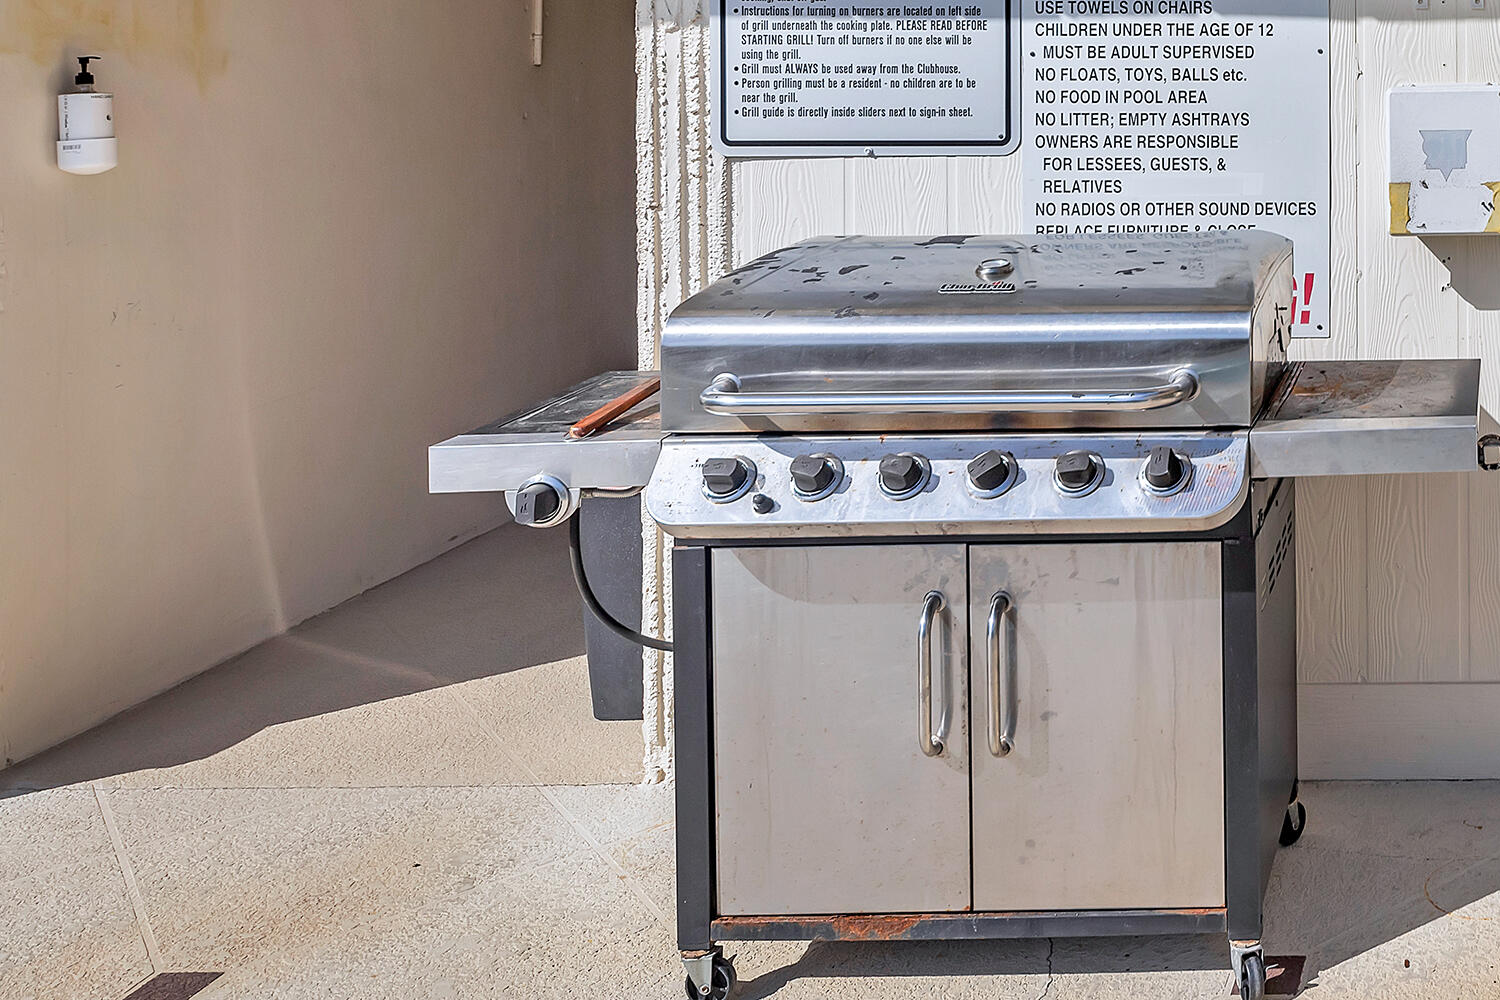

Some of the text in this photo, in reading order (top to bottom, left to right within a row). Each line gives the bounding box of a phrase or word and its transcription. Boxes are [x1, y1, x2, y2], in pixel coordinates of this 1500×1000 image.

[1036, 23, 1273, 36] CHILDREN UNDER THE AGE OF 12
[1044, 46, 1254, 58] MUST BE ADULT SUPERVISED
[742, 64, 960, 75] Grill must ALWAYS be used away from the Clubhouse.
[742, 106, 972, 118] Grill guide is directly inside sliders next to sign-in sheet.
[1036, 135, 1238, 148] OWNERS ARE RESPONSIBLE
[1036, 202, 1316, 216] NO RADIOS OR OTHER SOUND DEVICES
